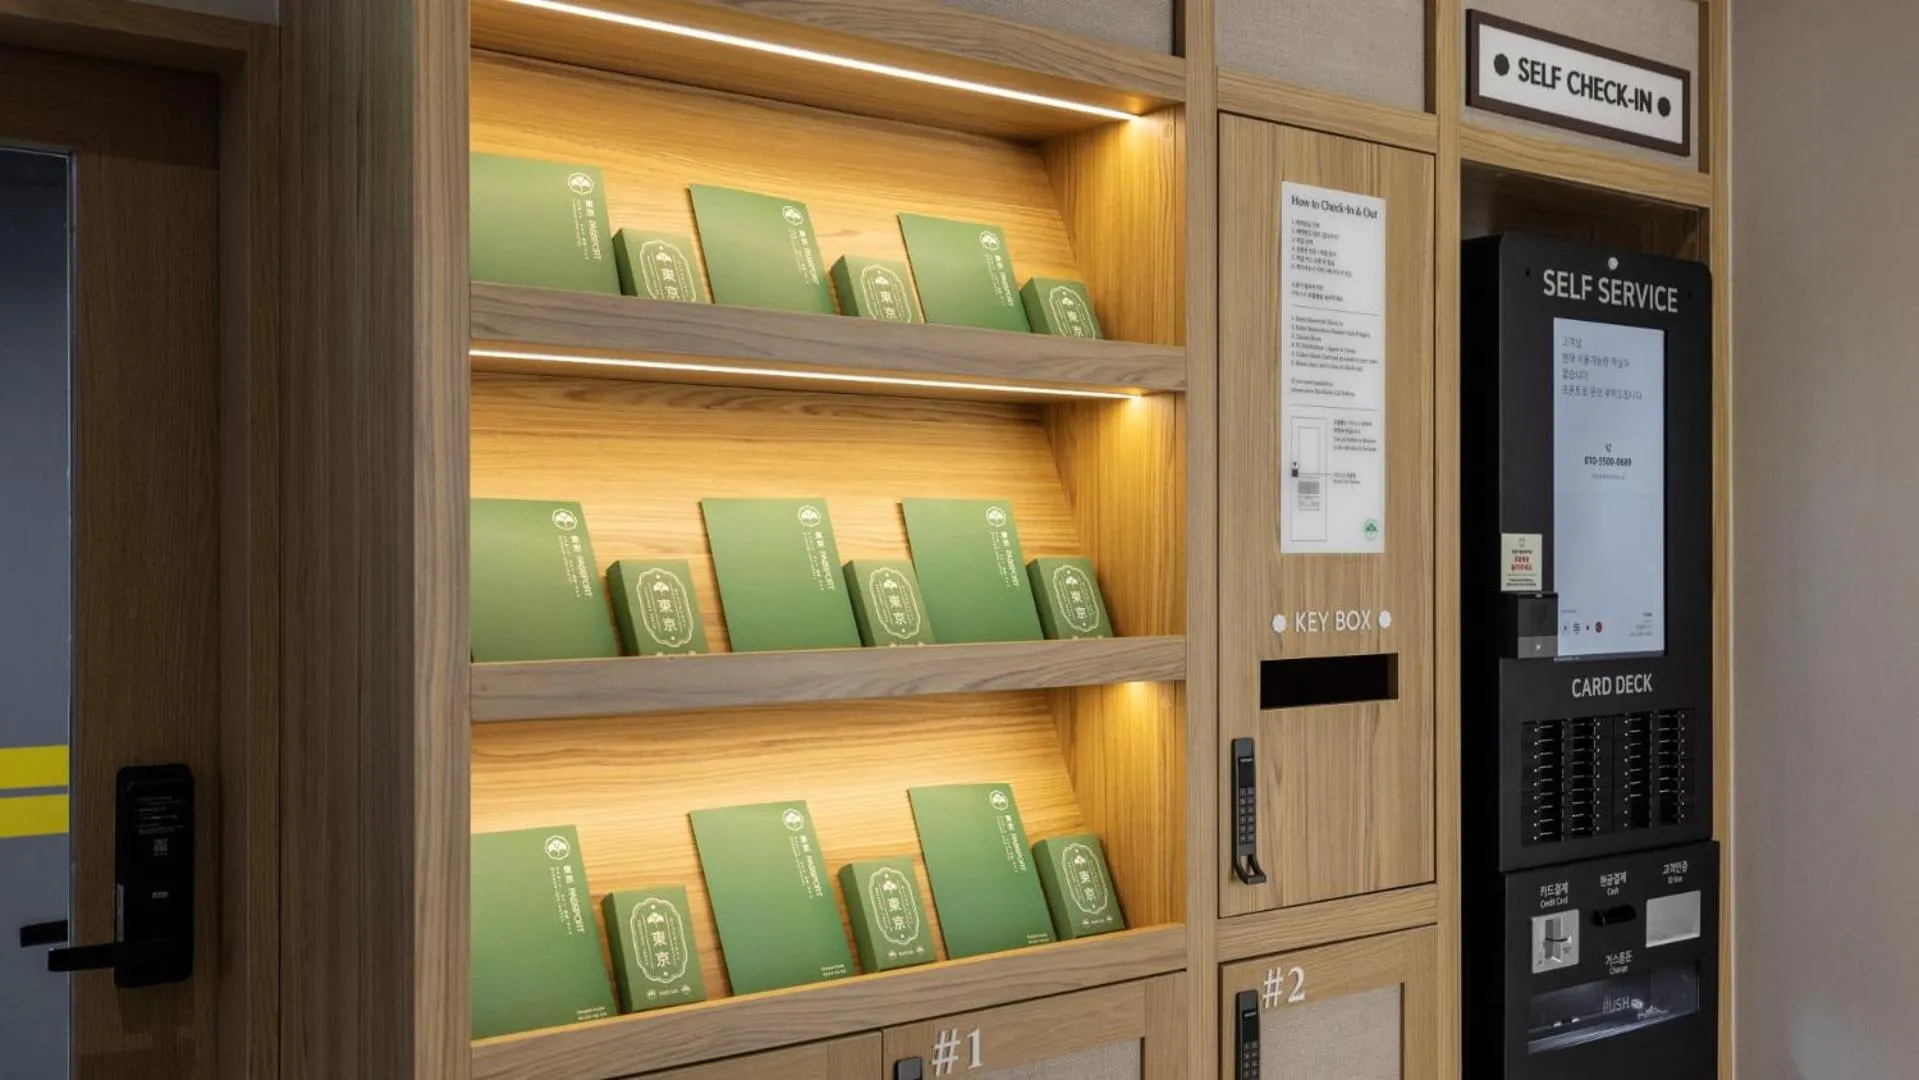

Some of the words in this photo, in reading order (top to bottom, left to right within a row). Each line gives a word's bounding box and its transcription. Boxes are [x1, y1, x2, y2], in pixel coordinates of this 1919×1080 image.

[1518, 57, 1562, 90] SELF
[1567, 71, 1653, 115] CHECK-IN
[1291, 195, 1311, 208] How
[1312, 198, 1320, 209] to
[1321, 200, 1355, 215] Check-In
[1355, 207, 1363, 217] &
[1363, 208, 1379, 220] Out
[586, 219, 602, 261] PASSPORT
[1543, 268, 1593, 301] SELF
[1598, 277, 1679, 313] SERVICE
[576, 555, 593, 598] PASSPORT
[656, 598, 678, 633] 東京
[1295, 611, 1329, 633] KEY
[1336, 610, 1371, 632] BOX
[1571, 676, 1612, 699] CARD
[1616, 673, 1653, 694] DECK
[806, 855, 824, 898] PASSPORT
[1539, 881, 1569, 897] 카드결제
[568, 887, 585, 934] PASSPORT
[1556, 897, 1568, 906] Card
[651, 929, 672, 968] 東京
[1262, 966, 1306, 1010] #2
[1602, 996, 1630, 1014] PUSH
[931, 1027, 984, 1077] #1
